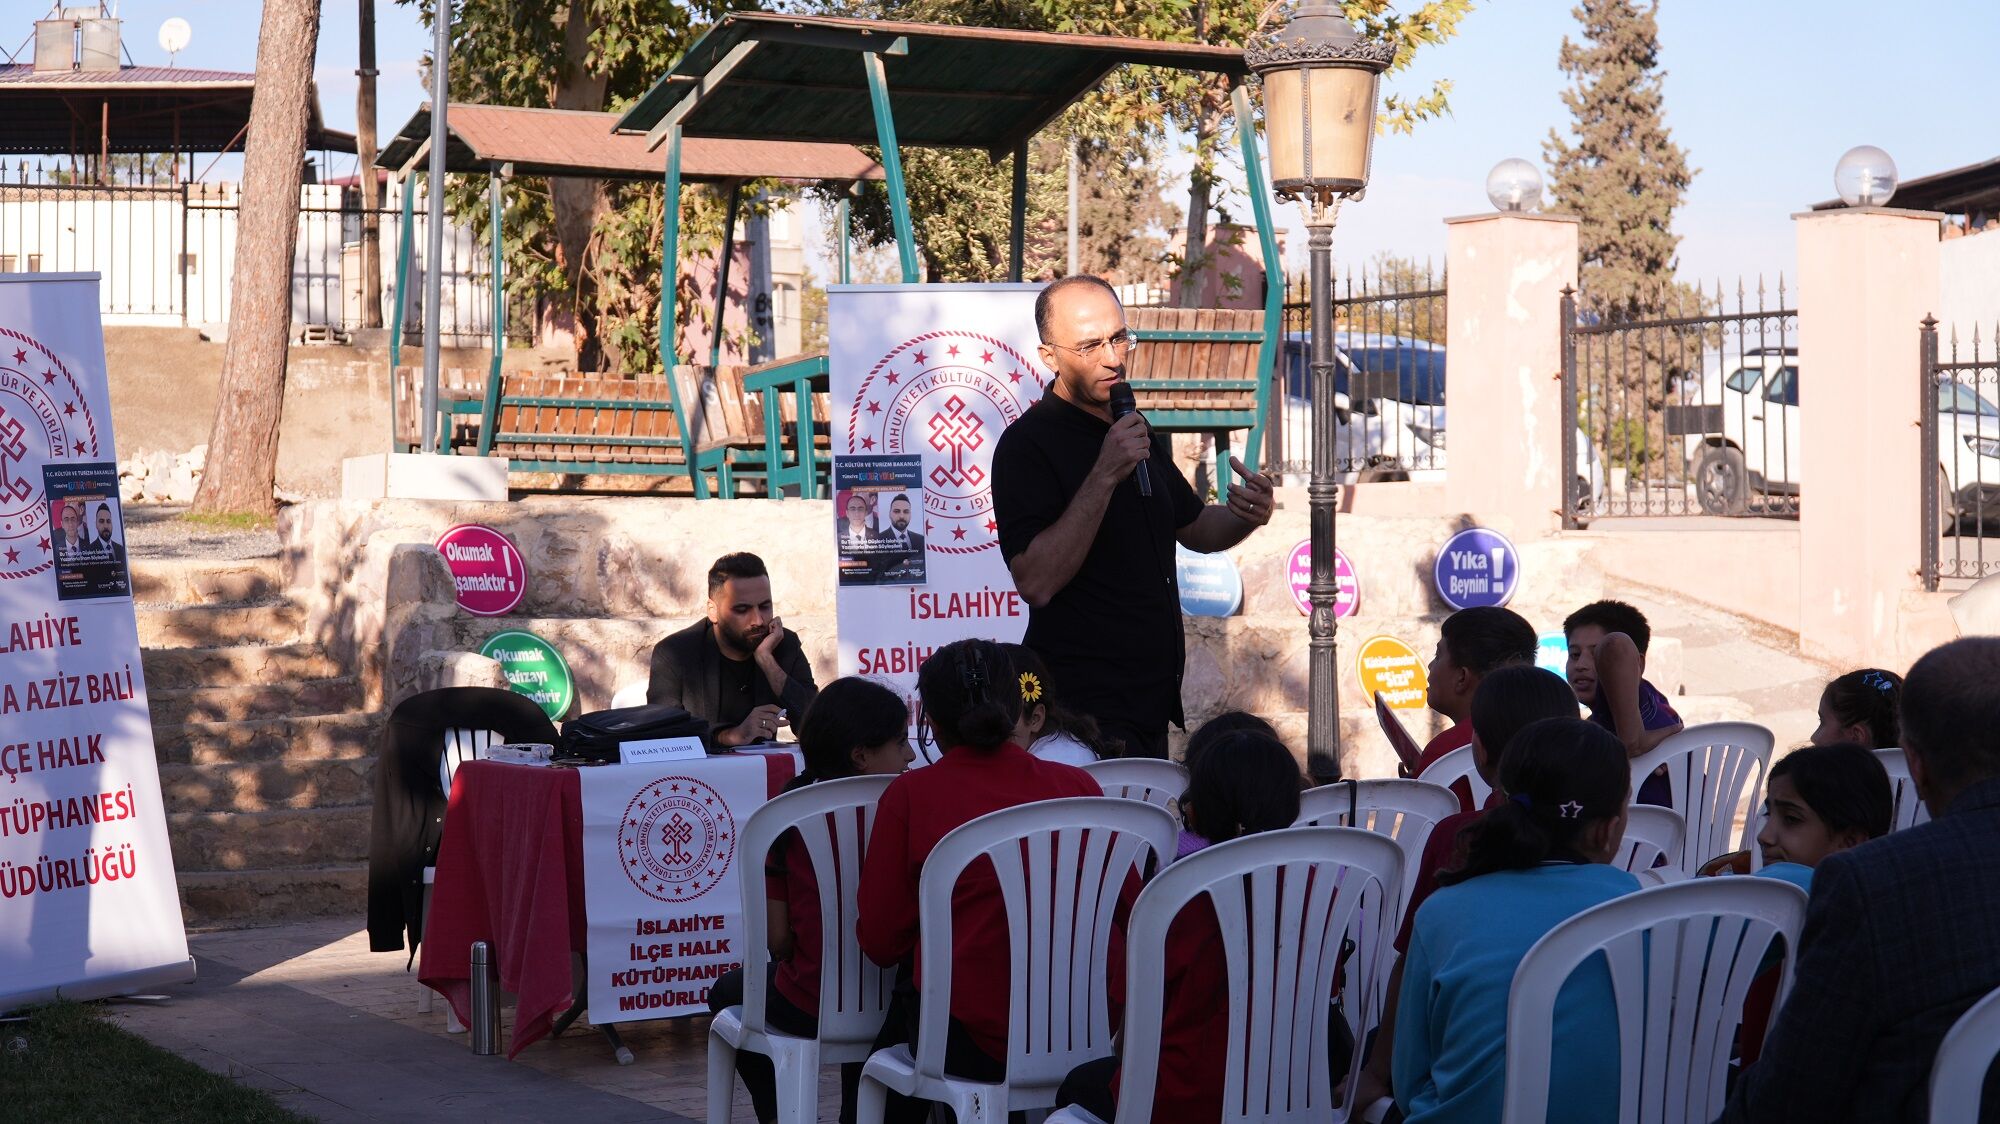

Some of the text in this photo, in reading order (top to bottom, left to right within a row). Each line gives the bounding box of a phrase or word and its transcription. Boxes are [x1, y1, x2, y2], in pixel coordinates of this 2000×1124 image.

[930, 371, 982, 387] KÜLTÜR
[985, 381, 1000, 398] VE
[22, 383, 37, 401] VE
[37, 399, 64, 457] TURİZM
[889, 379, 929, 454] MHURİYETİ
[999, 396, 1019, 423] TUR
[924, 492, 948, 511] TÜR
[446, 542, 495, 561] Okumak
[1450, 551, 1488, 570] Yıka
[453, 573, 506, 596] şamaktır
[1450, 574, 1488, 600] Beynini
[910, 586, 1020, 619] İSLAHİYE
[493, 648, 545, 662] Okumak
[858, 641, 932, 675] SABİH
[27, 671, 83, 711] AZİZ
[86, 663, 133, 704] BALİ
[503, 670, 548, 686] afızayı
[0, 734, 105, 784] ÇE HALK
[630, 744, 693, 756] HAKAN YILDIRIM
[0, 783, 136, 837] TÜPHANESİ
[640, 799, 714, 878] TÜRKİYE CUMHURİYETİ KÜLTÜR VE TURİZM BAKANLIĞI
[0, 843, 136, 898] ÜDÜRLÜĞÜ
[636, 914, 725, 935] İSLAHİYE
[630, 939, 731, 962] İLÇE HALK
[612, 961, 744, 987] KÜTÜPHANES
[620, 986, 711, 1011] MÜDÜRLÜ
